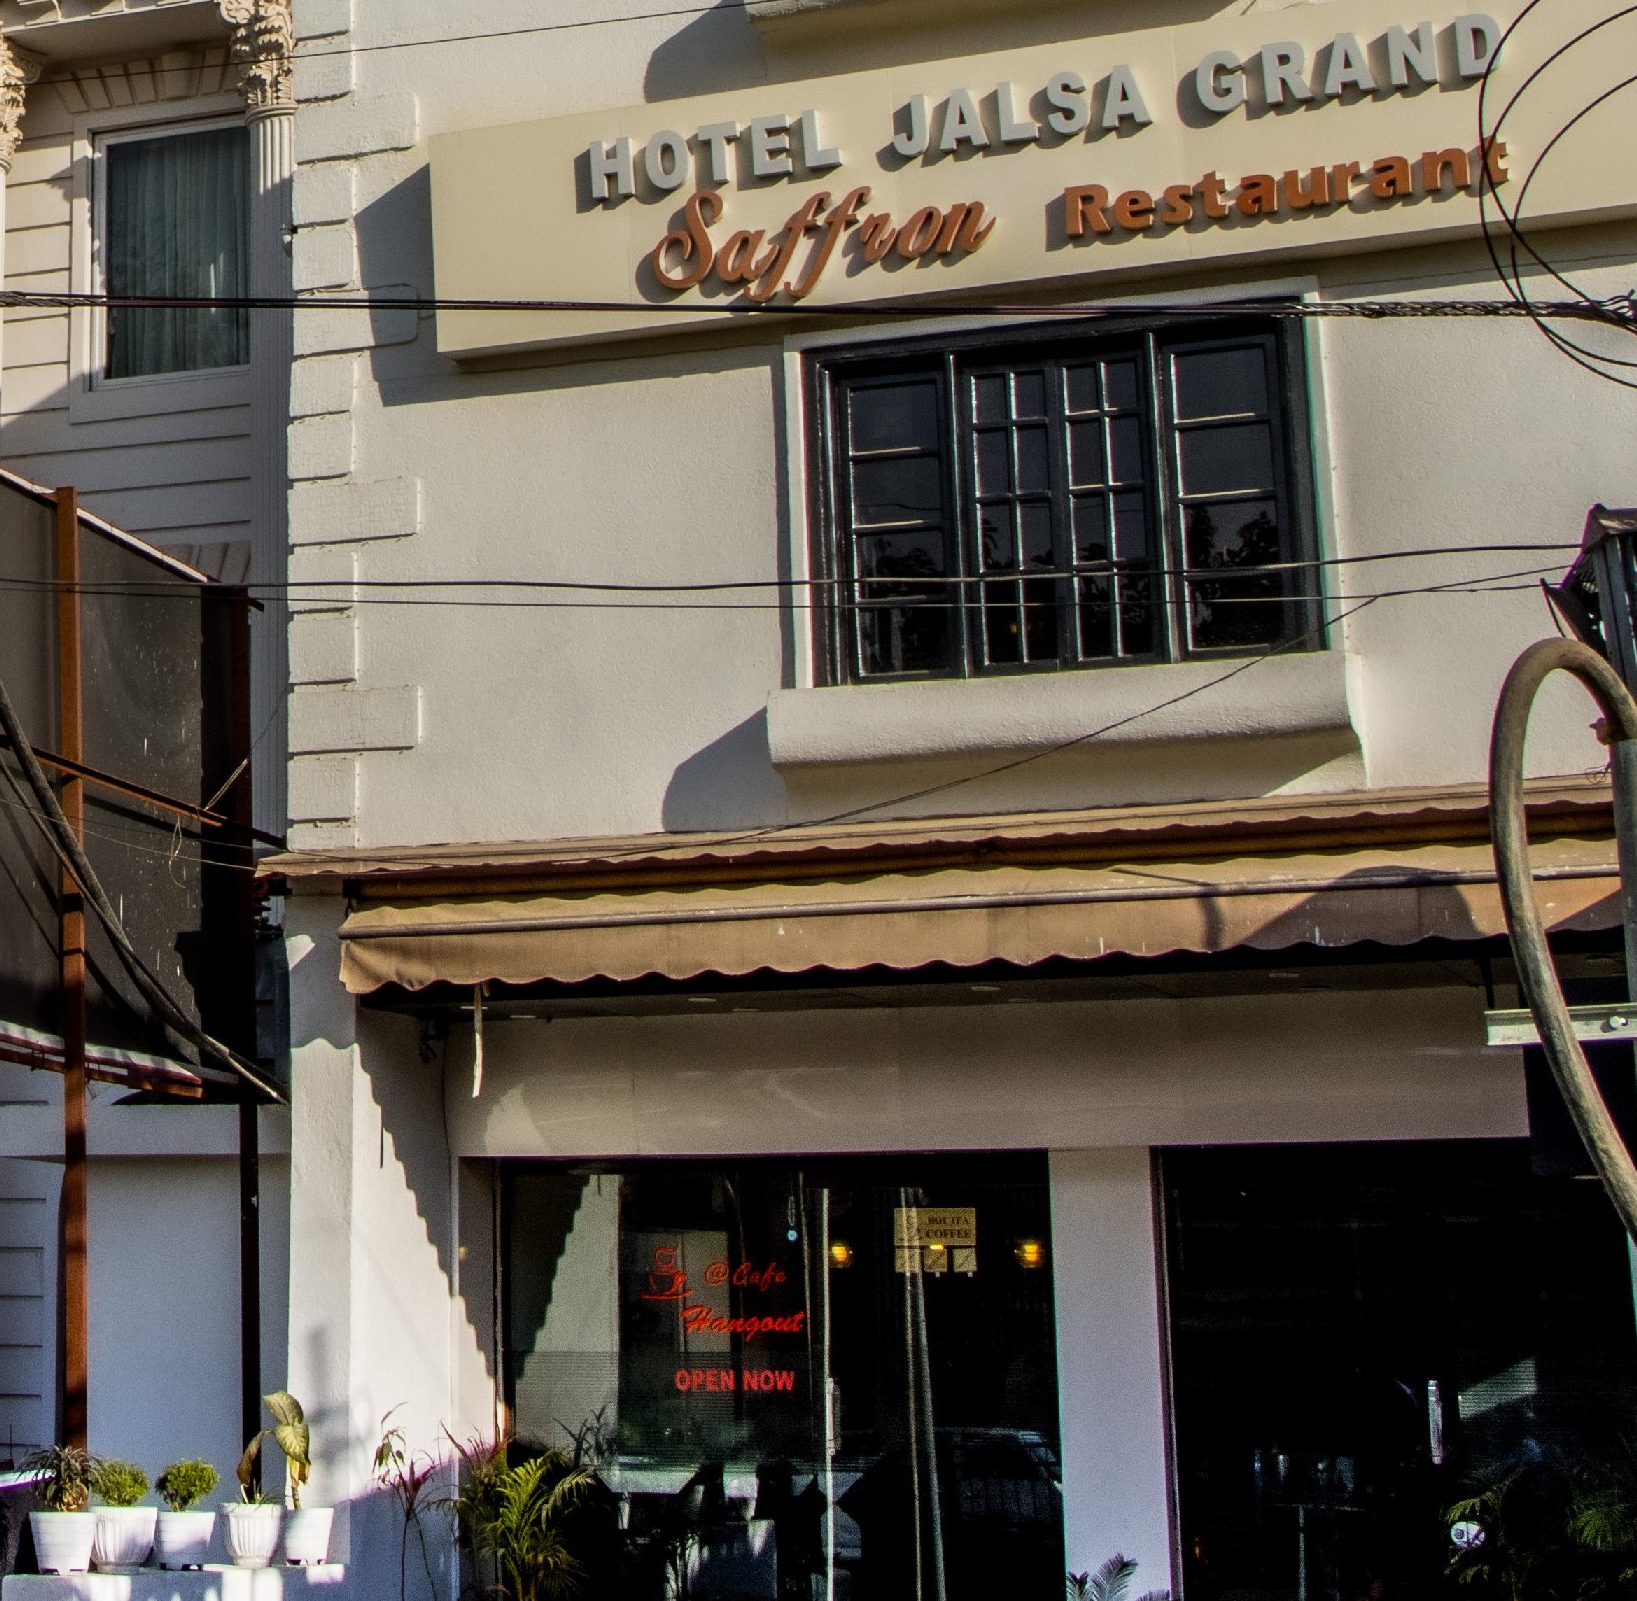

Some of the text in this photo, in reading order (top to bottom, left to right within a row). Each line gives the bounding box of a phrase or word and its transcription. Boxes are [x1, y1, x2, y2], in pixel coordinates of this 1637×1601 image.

[588, 12, 1503, 202] HOTEL JALSA GRAND
[651, 135, 1509, 302] Saffron Restaurant
[681, 1304, 805, 1341] Hangout
[674, 1368, 795, 1391] OPEN NOW
